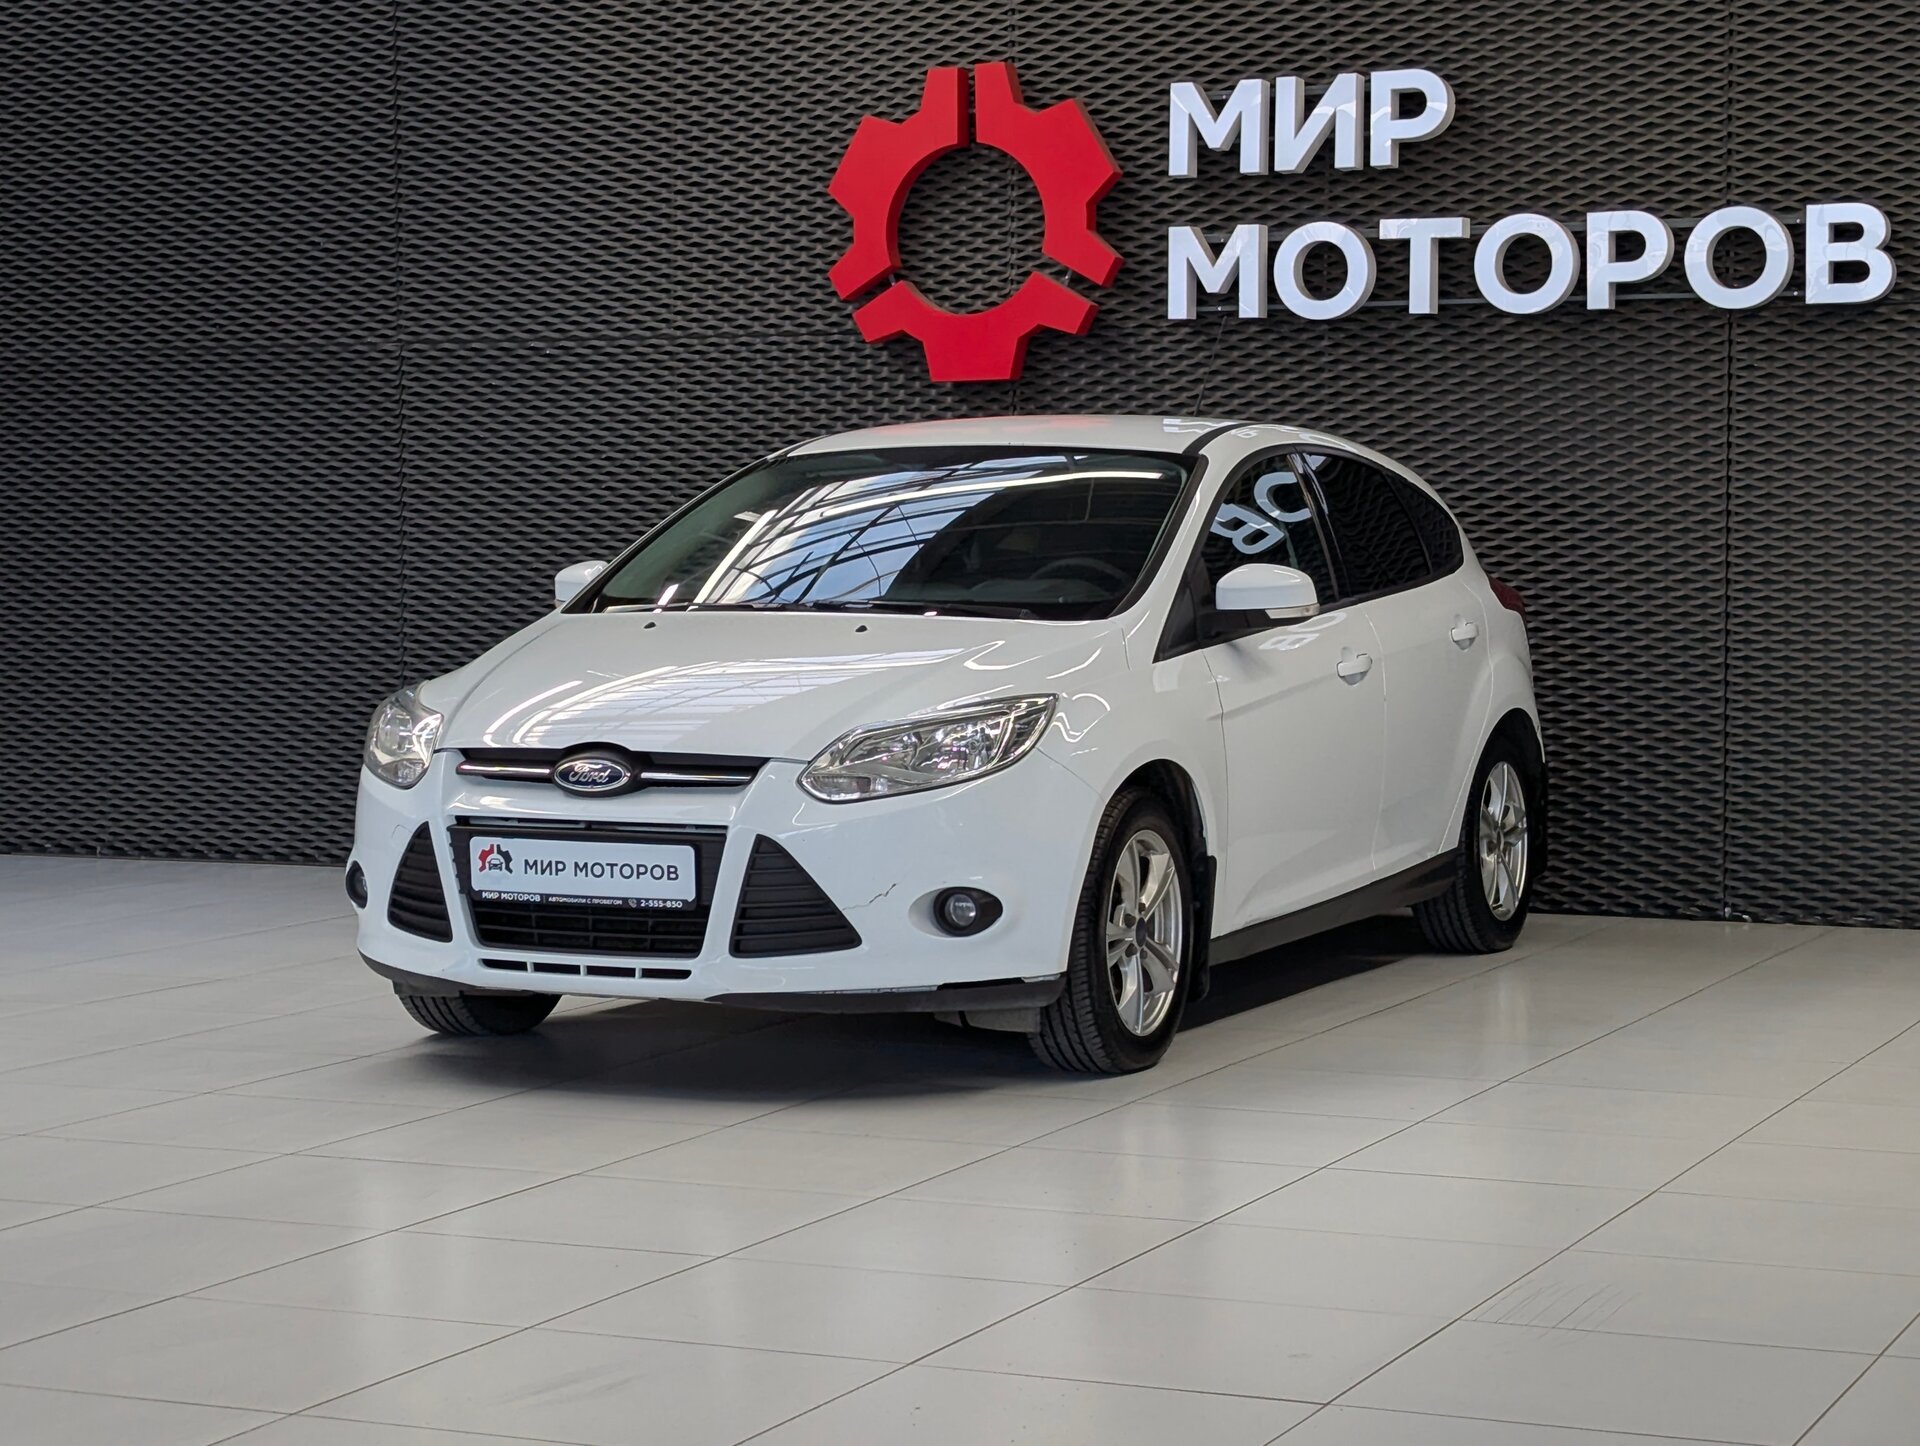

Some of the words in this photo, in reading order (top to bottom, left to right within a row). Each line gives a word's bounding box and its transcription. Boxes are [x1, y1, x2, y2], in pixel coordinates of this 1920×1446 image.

[1168, 68, 1456, 178] МИР
[1167, 202, 1897, 321] МОТОРОВ
[568, 763, 611, 783] Ford
[524, 858, 567, 876] МИР
[573, 862, 680, 882] МОТОРОВ
[482, 891, 499, 899] МИР
[501, 892, 541, 902] МОТОРОВ
[640, 900, 683, 908] 2-555-850
